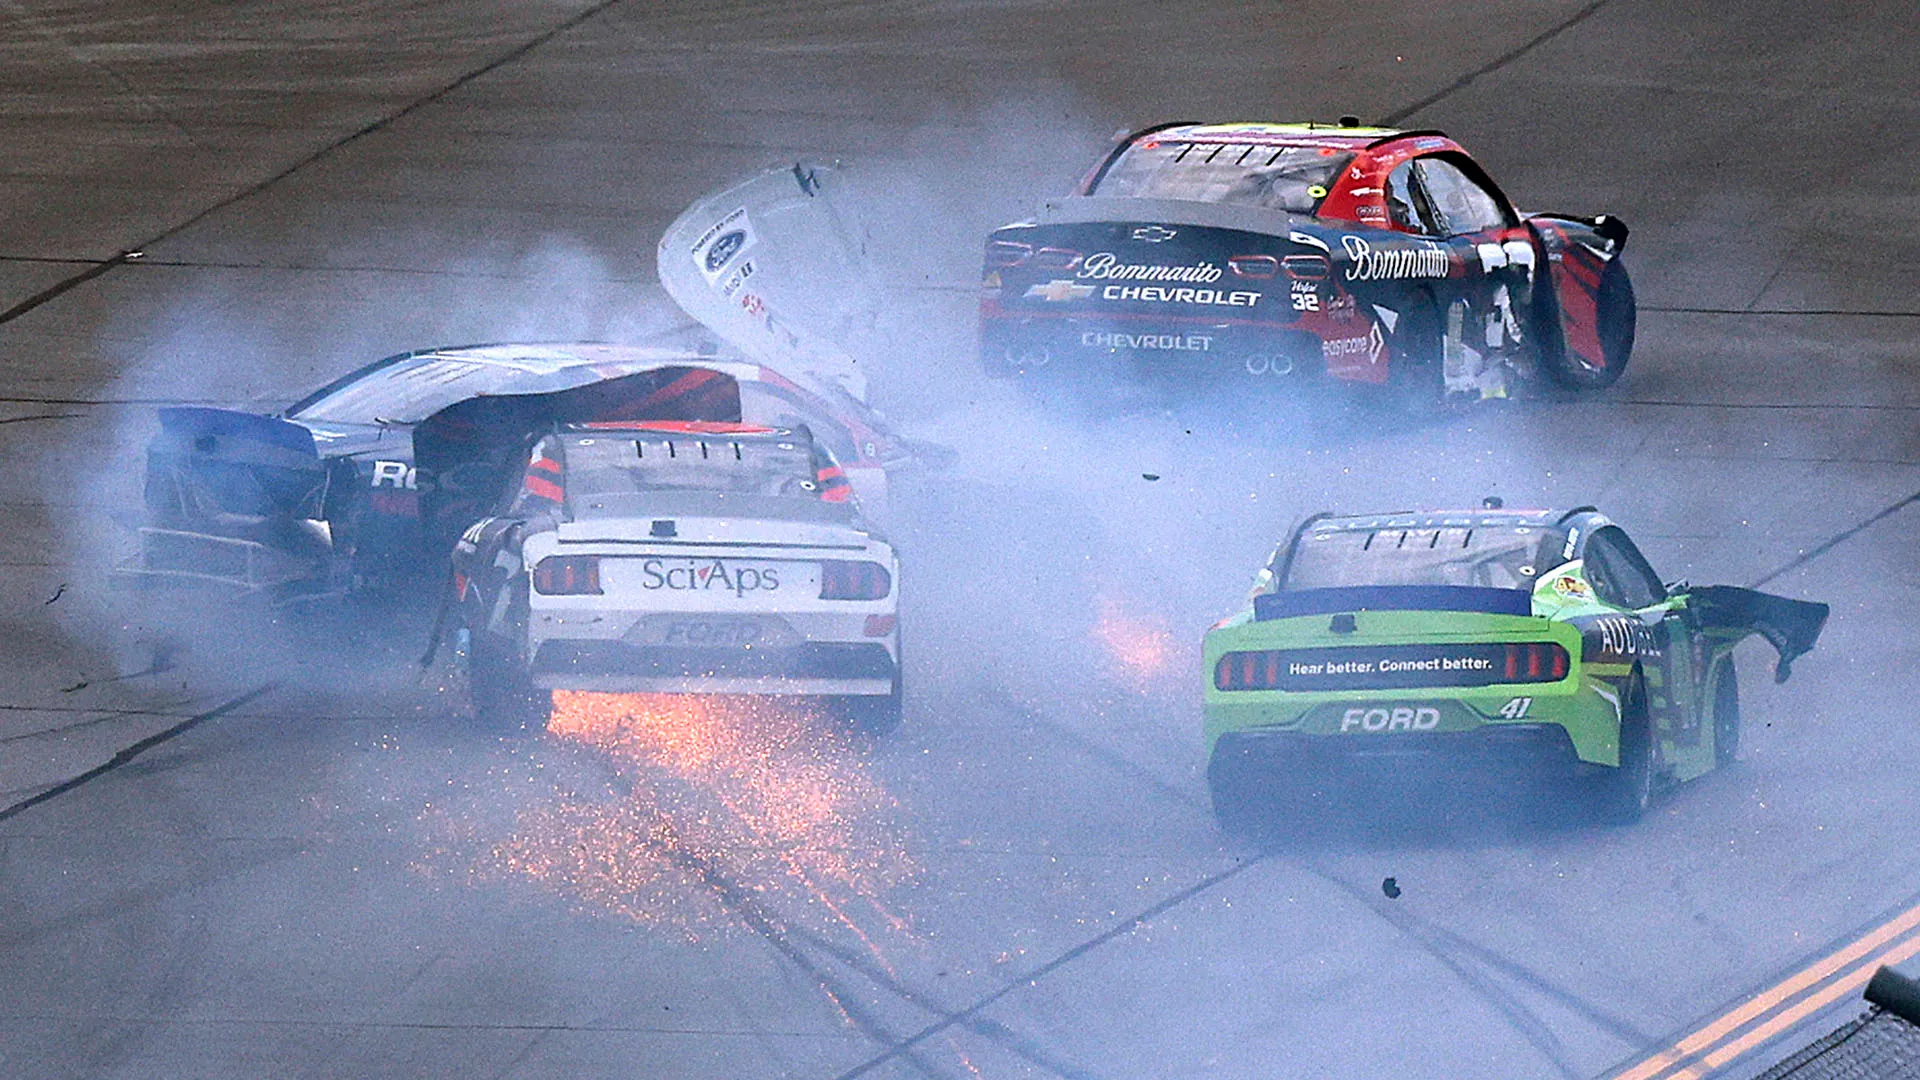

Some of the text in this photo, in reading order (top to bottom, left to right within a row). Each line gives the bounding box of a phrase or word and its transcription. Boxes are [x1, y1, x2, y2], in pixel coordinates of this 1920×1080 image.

[1076, 252, 1222, 283] Bommarito
[1341, 234, 1449, 281] Bommarito
[1103, 285, 1262, 307] CHEVROLET
[1290, 293, 1320, 312] 32
[1081, 331, 1213, 350] CHEVROLET
[642, 560, 779, 598] SciAps
[1289, 657, 1493, 675] Hear better. Connect better.
[1499, 696, 1533, 719] 41
[1340, 707, 1441, 733] FORD
